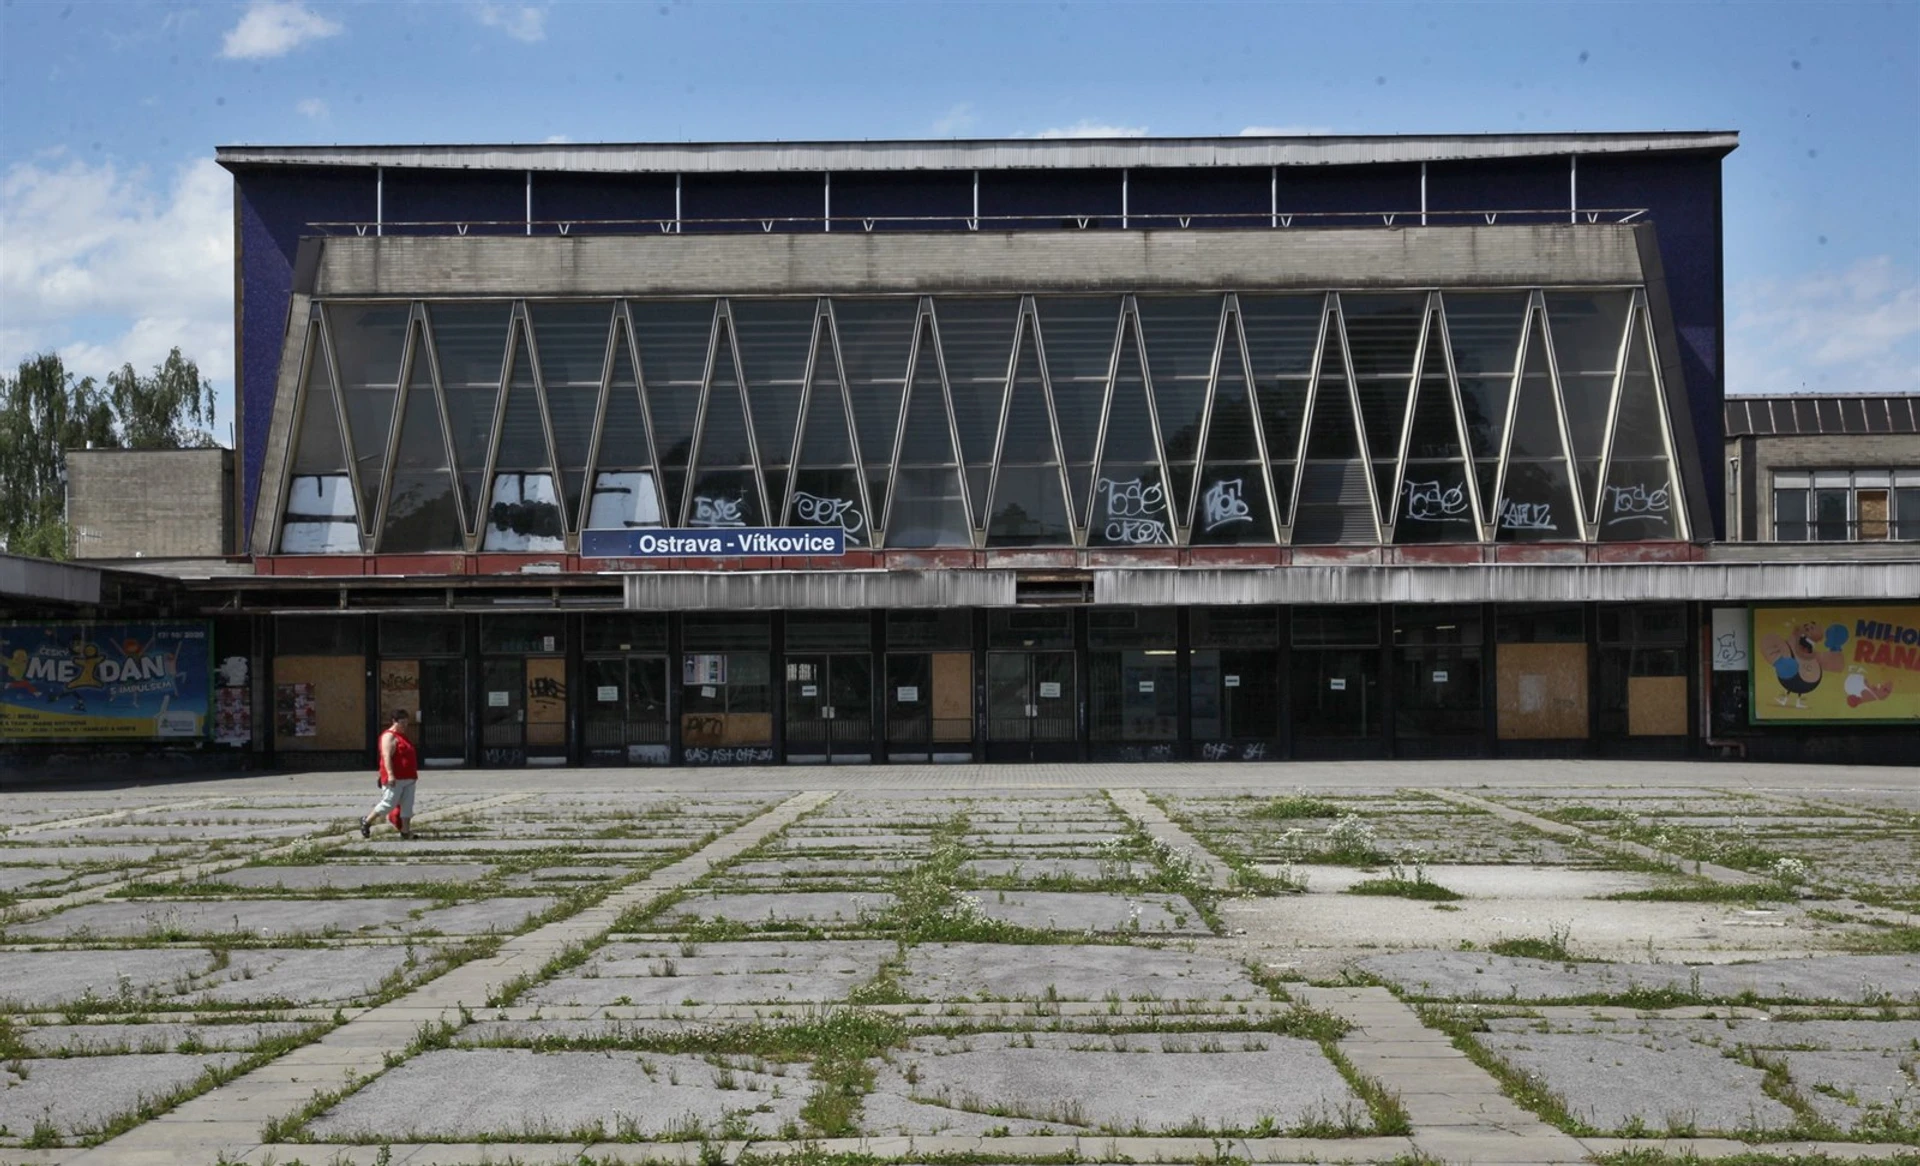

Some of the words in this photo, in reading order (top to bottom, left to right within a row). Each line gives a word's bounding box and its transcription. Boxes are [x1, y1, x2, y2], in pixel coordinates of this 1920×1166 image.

[639, 535, 722, 553] Ostrava
[738, 532, 836, 552] Vítkovice
[1855, 619, 1920, 646] MILIO
